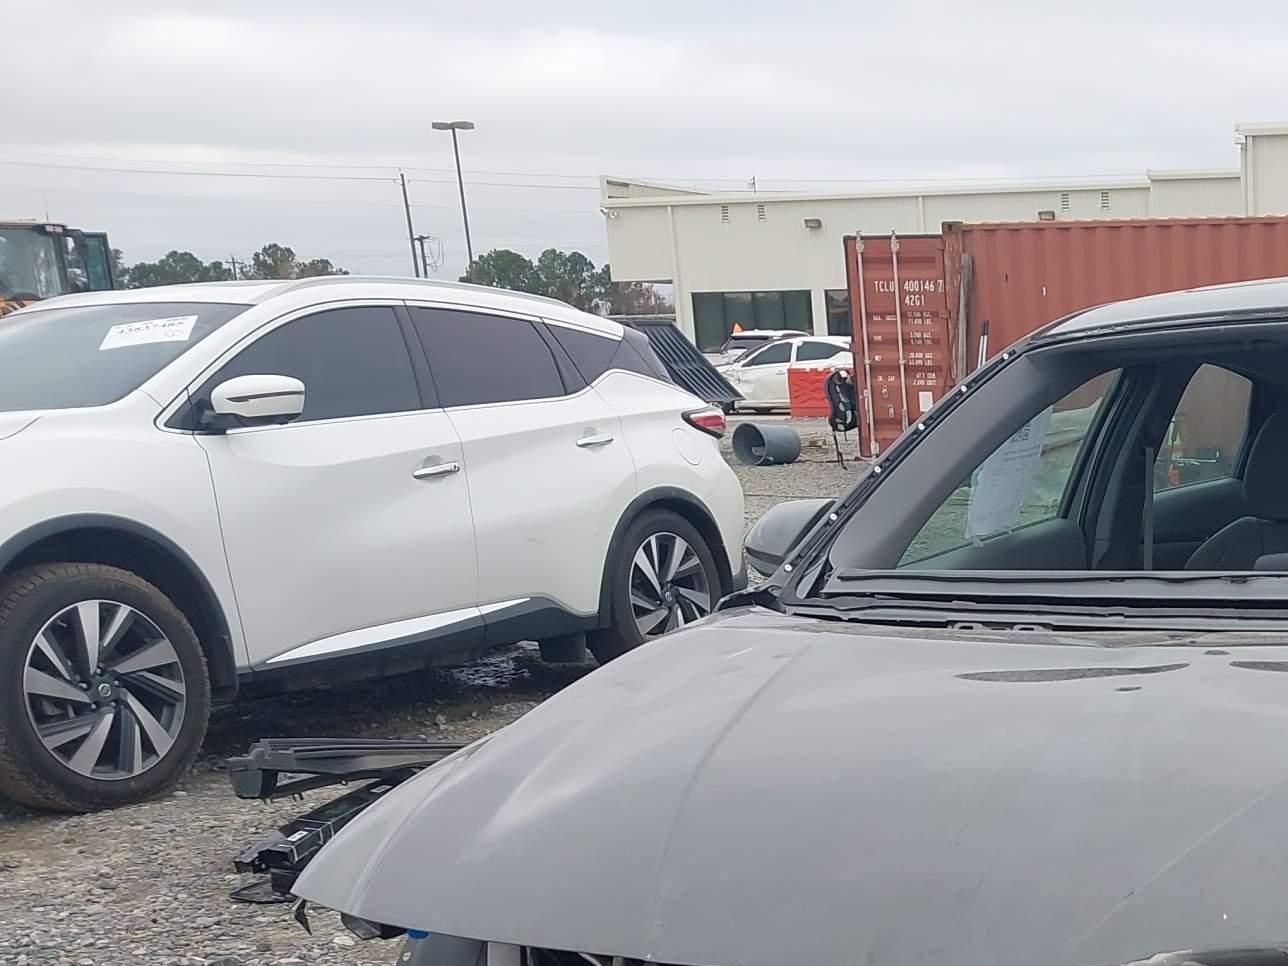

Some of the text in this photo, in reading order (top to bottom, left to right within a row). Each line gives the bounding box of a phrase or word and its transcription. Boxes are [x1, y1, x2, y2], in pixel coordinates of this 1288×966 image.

[874, 280, 895, 292] TCLU
[904, 280, 935, 292] 400146
[905, 294, 925, 307] 42G1
